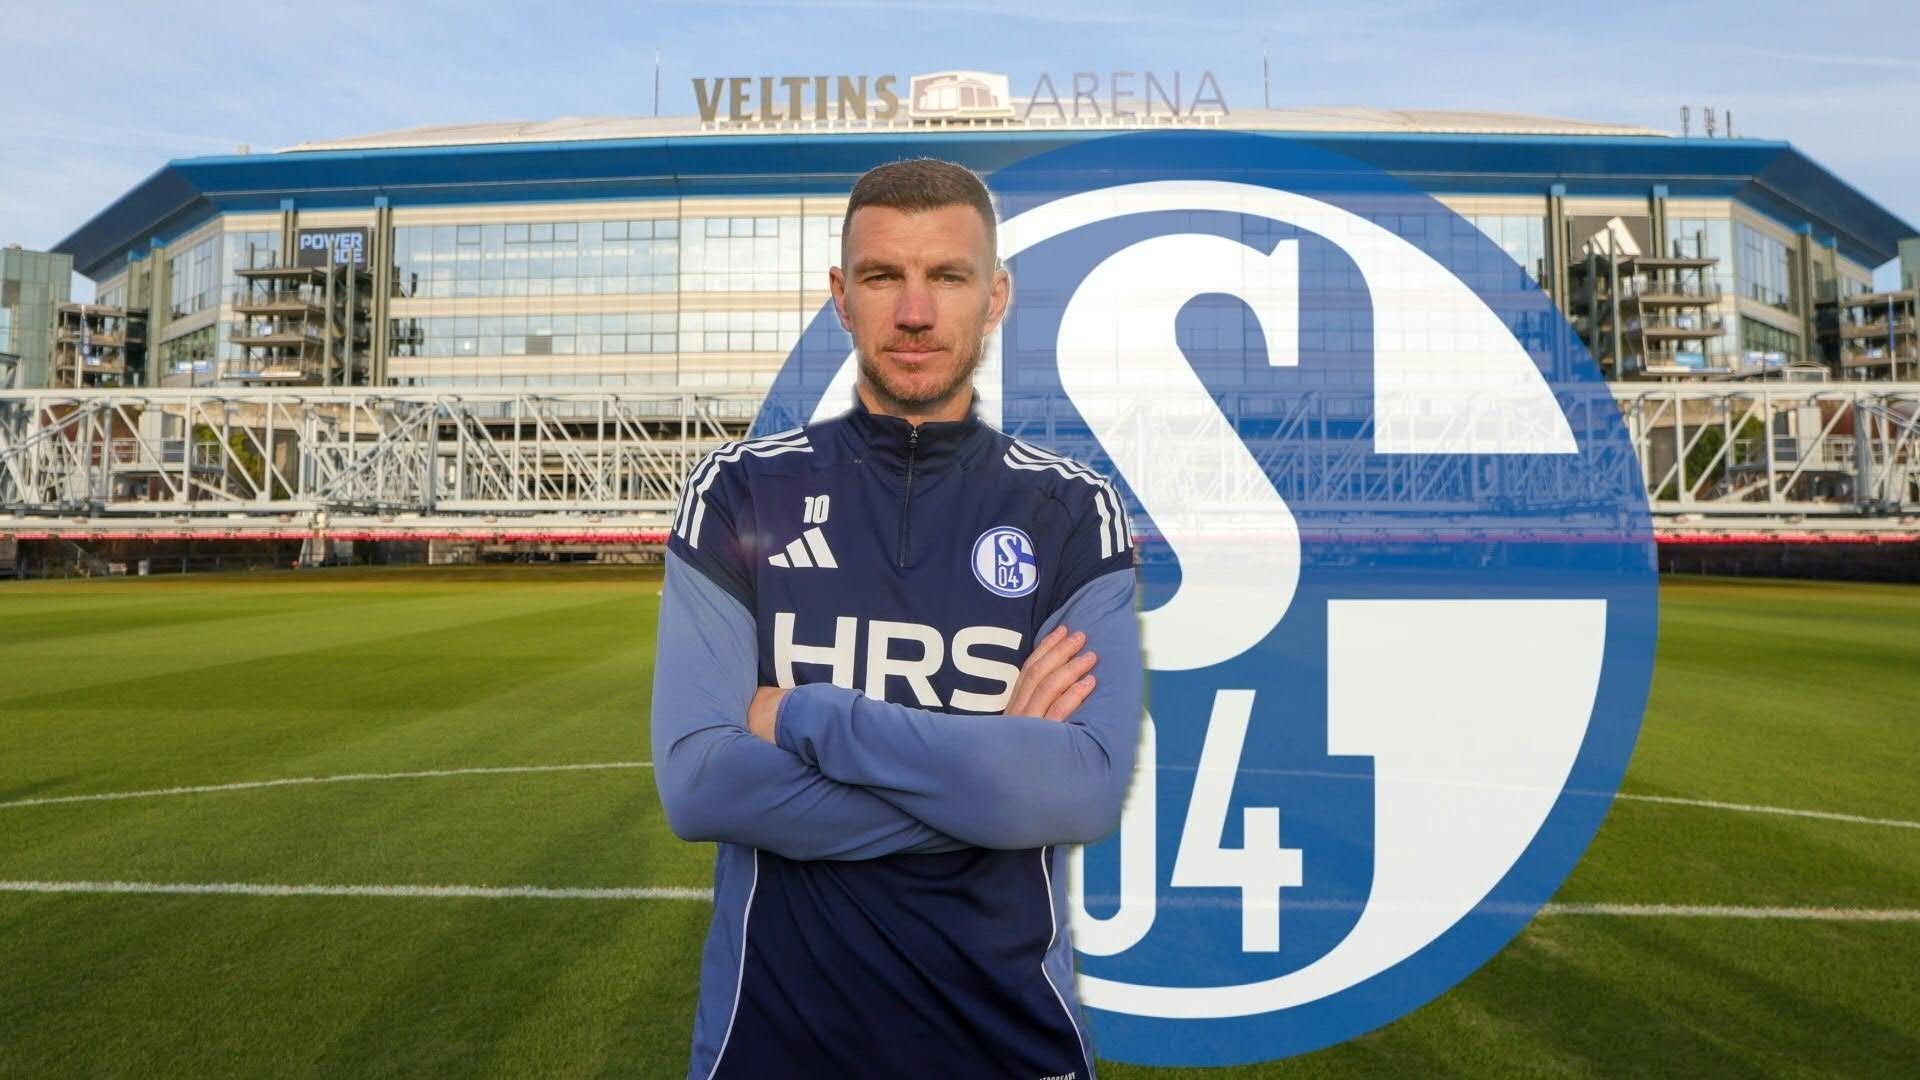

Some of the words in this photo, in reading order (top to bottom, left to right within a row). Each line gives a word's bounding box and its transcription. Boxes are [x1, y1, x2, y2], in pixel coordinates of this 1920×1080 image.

[691, 74, 898, 121] VELTINS
[1024, 70, 1231, 118] ARENA
[300, 231, 363, 250] POWER
[803, 494, 830, 523] 10
[998, 566, 1020, 588] 04
[773, 612, 1023, 713] HRS
